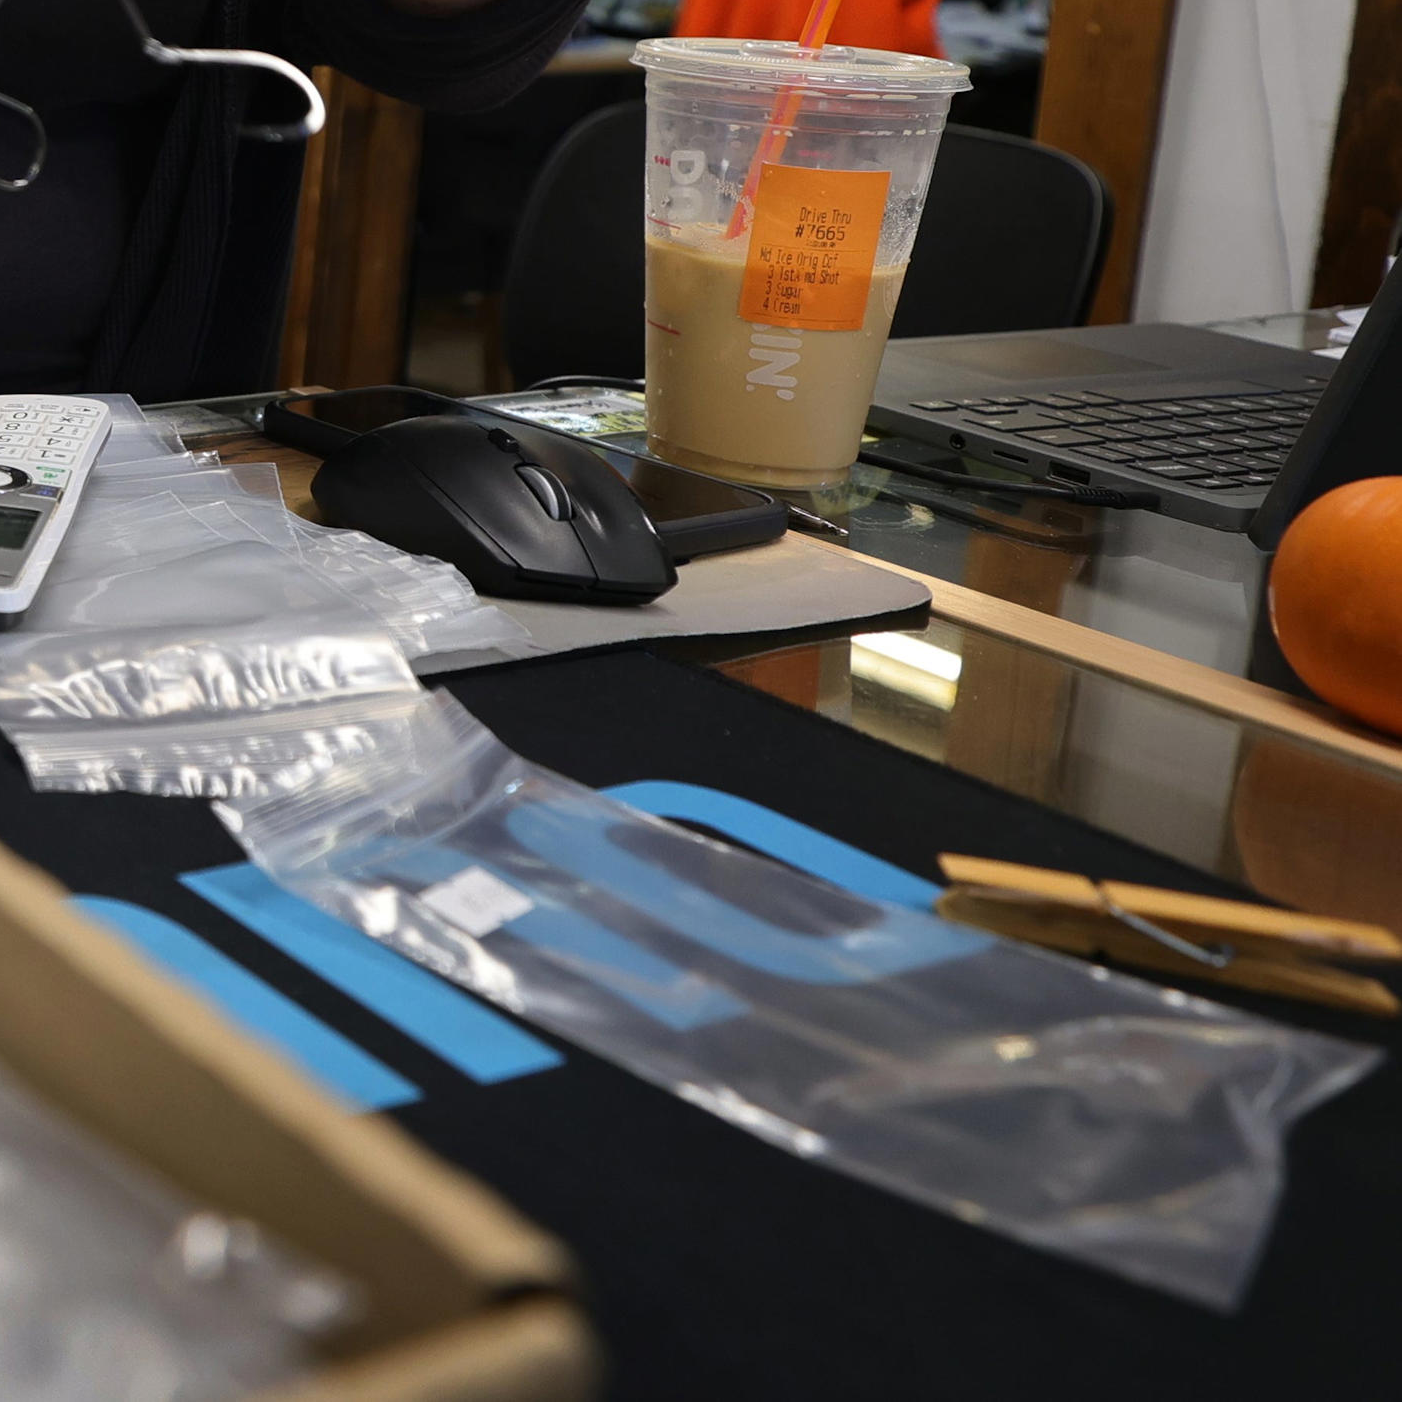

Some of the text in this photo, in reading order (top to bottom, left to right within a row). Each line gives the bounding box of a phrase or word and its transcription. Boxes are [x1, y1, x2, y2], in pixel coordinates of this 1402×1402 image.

[799, 206, 852, 225] Drive Thru
[795, 223, 846, 242] #7665
[776, 248, 794, 266] Ice
[796, 251, 819, 271] Orig
[767, 264, 776, 280] 3
[819, 268, 841, 286] Shot
[765, 280, 803, 300] 3 Sugar
[762, 297, 803, 315] 4 Cream
